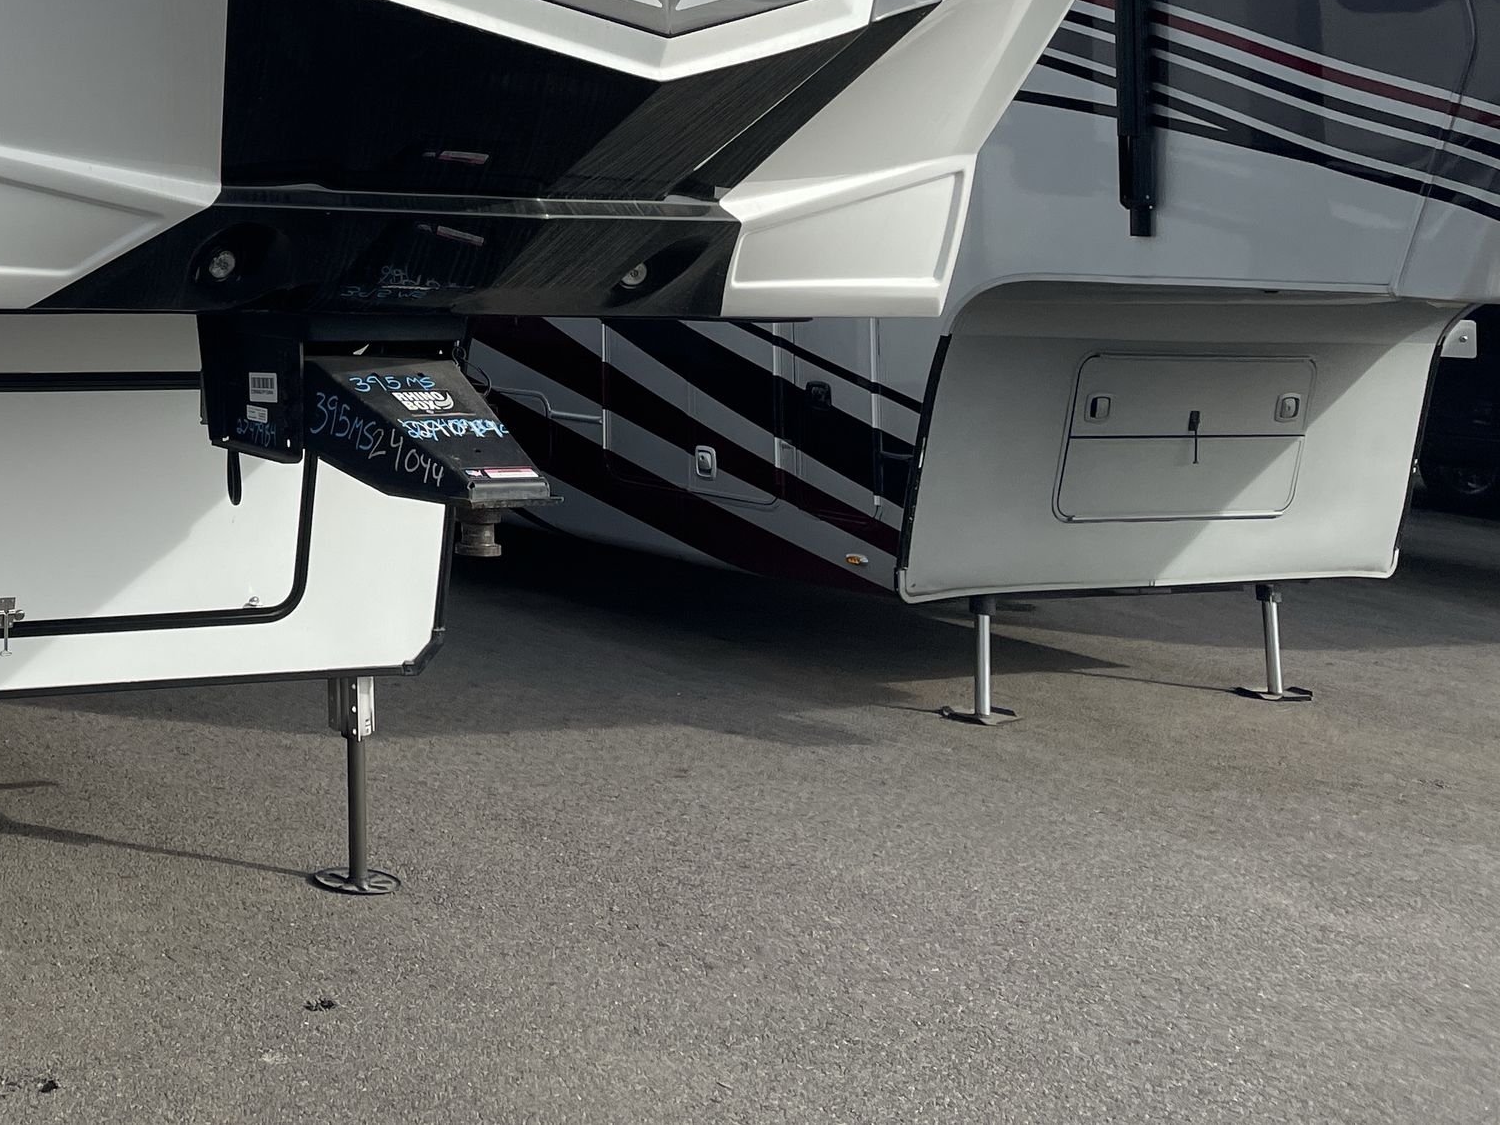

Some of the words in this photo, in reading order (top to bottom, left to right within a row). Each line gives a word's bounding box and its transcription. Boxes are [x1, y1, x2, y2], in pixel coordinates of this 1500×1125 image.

[349, 375, 401, 392] 395
[406, 376, 436, 391] MS
[391, 391, 445, 401] RHINO
[401, 400, 442, 411] BOX
